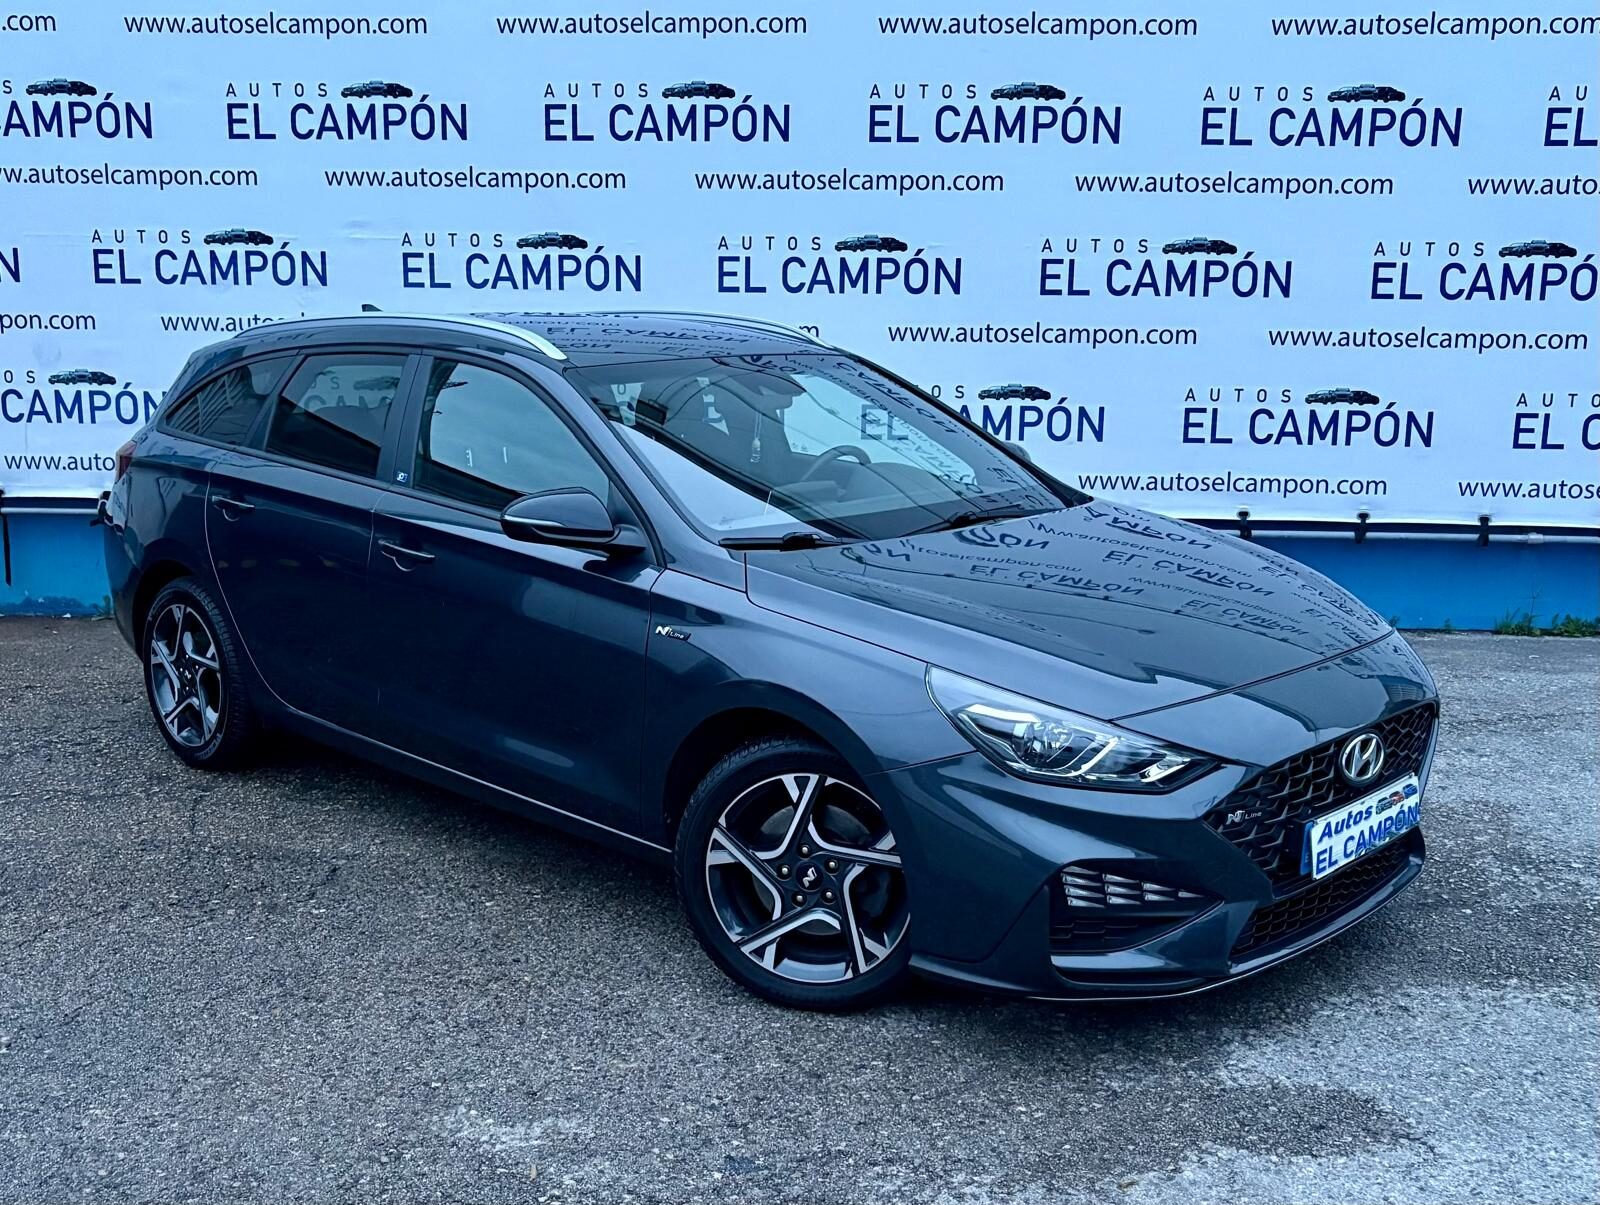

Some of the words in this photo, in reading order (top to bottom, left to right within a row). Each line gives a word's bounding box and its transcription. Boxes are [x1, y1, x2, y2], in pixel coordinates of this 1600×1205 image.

[124, 12, 427, 40] www.autoselcampon.com
[497, 10, 806, 39] www.autoselcampon.com
[879, 11, 1197, 40] www.autoselcampon.com
[226, 82, 327, 97] AUTOS
[544, 83, 648, 98] AUTOS
[870, 84, 976, 99] AUTOS
[1203, 86, 1313, 101] AUTOS
[0, 93, 152, 139] AMPÓN
[227, 103, 276, 139] EL
[291, 95, 467, 140] CAMPÓN
[545, 104, 594, 141] EL
[609, 96, 790, 142] CAMPÓN
[869, 105, 919, 143] EL
[935, 97, 1121, 144] CAMPÓN
[1201, 107, 1252, 146] EL
[1270, 99, 1462, 147] CAMPÓN
[1544, 107, 1598, 147] EL
[325, 166, 625, 193] www.autoselcampon.com
[695, 168, 1003, 196] www.autoselcampon.com
[1075, 171, 1393, 199] www.autoselcampon.com
[1468, 175, 1600, 195] www.auto
[92, 229, 190, 244] AUTOS
[402, 232, 503, 248] AUTOS
[718, 236, 821, 251] AUTOS
[1041, 238, 1148, 253] AUTOS
[1374, 242, 1484, 257] AUTOS
[93, 249, 141, 284] EL
[155, 242, 327, 286] CAMPÓN
[402, 252, 451, 288] EL
[466, 246, 641, 292] CAMPÓN
[718, 256, 767, 293] EL
[782, 249, 961, 295] CAMPÓN
[1040, 259, 1090, 296] EL
[1107, 252, 1292, 298] CAMPÓN
[1371, 262, 1422, 300] EL
[888, 322, 1196, 349] www.autoselcampon.com
[1269, 326, 1587, 354] www.autoselcampon.com
[1184, 388, 1291, 403] AUTOS
[1183, 408, 1233, 444] EL
[1249, 402, 1434, 447] CAMPÓN
[1512, 413, 1564, 450] EL
[1078, 470, 1388, 498] www.autoselcampon.com
[1316, 845, 1338, 876] EL
[1343, 802, 1419, 859] CAMPÓN
[1317, 805, 1373, 845] Autos
